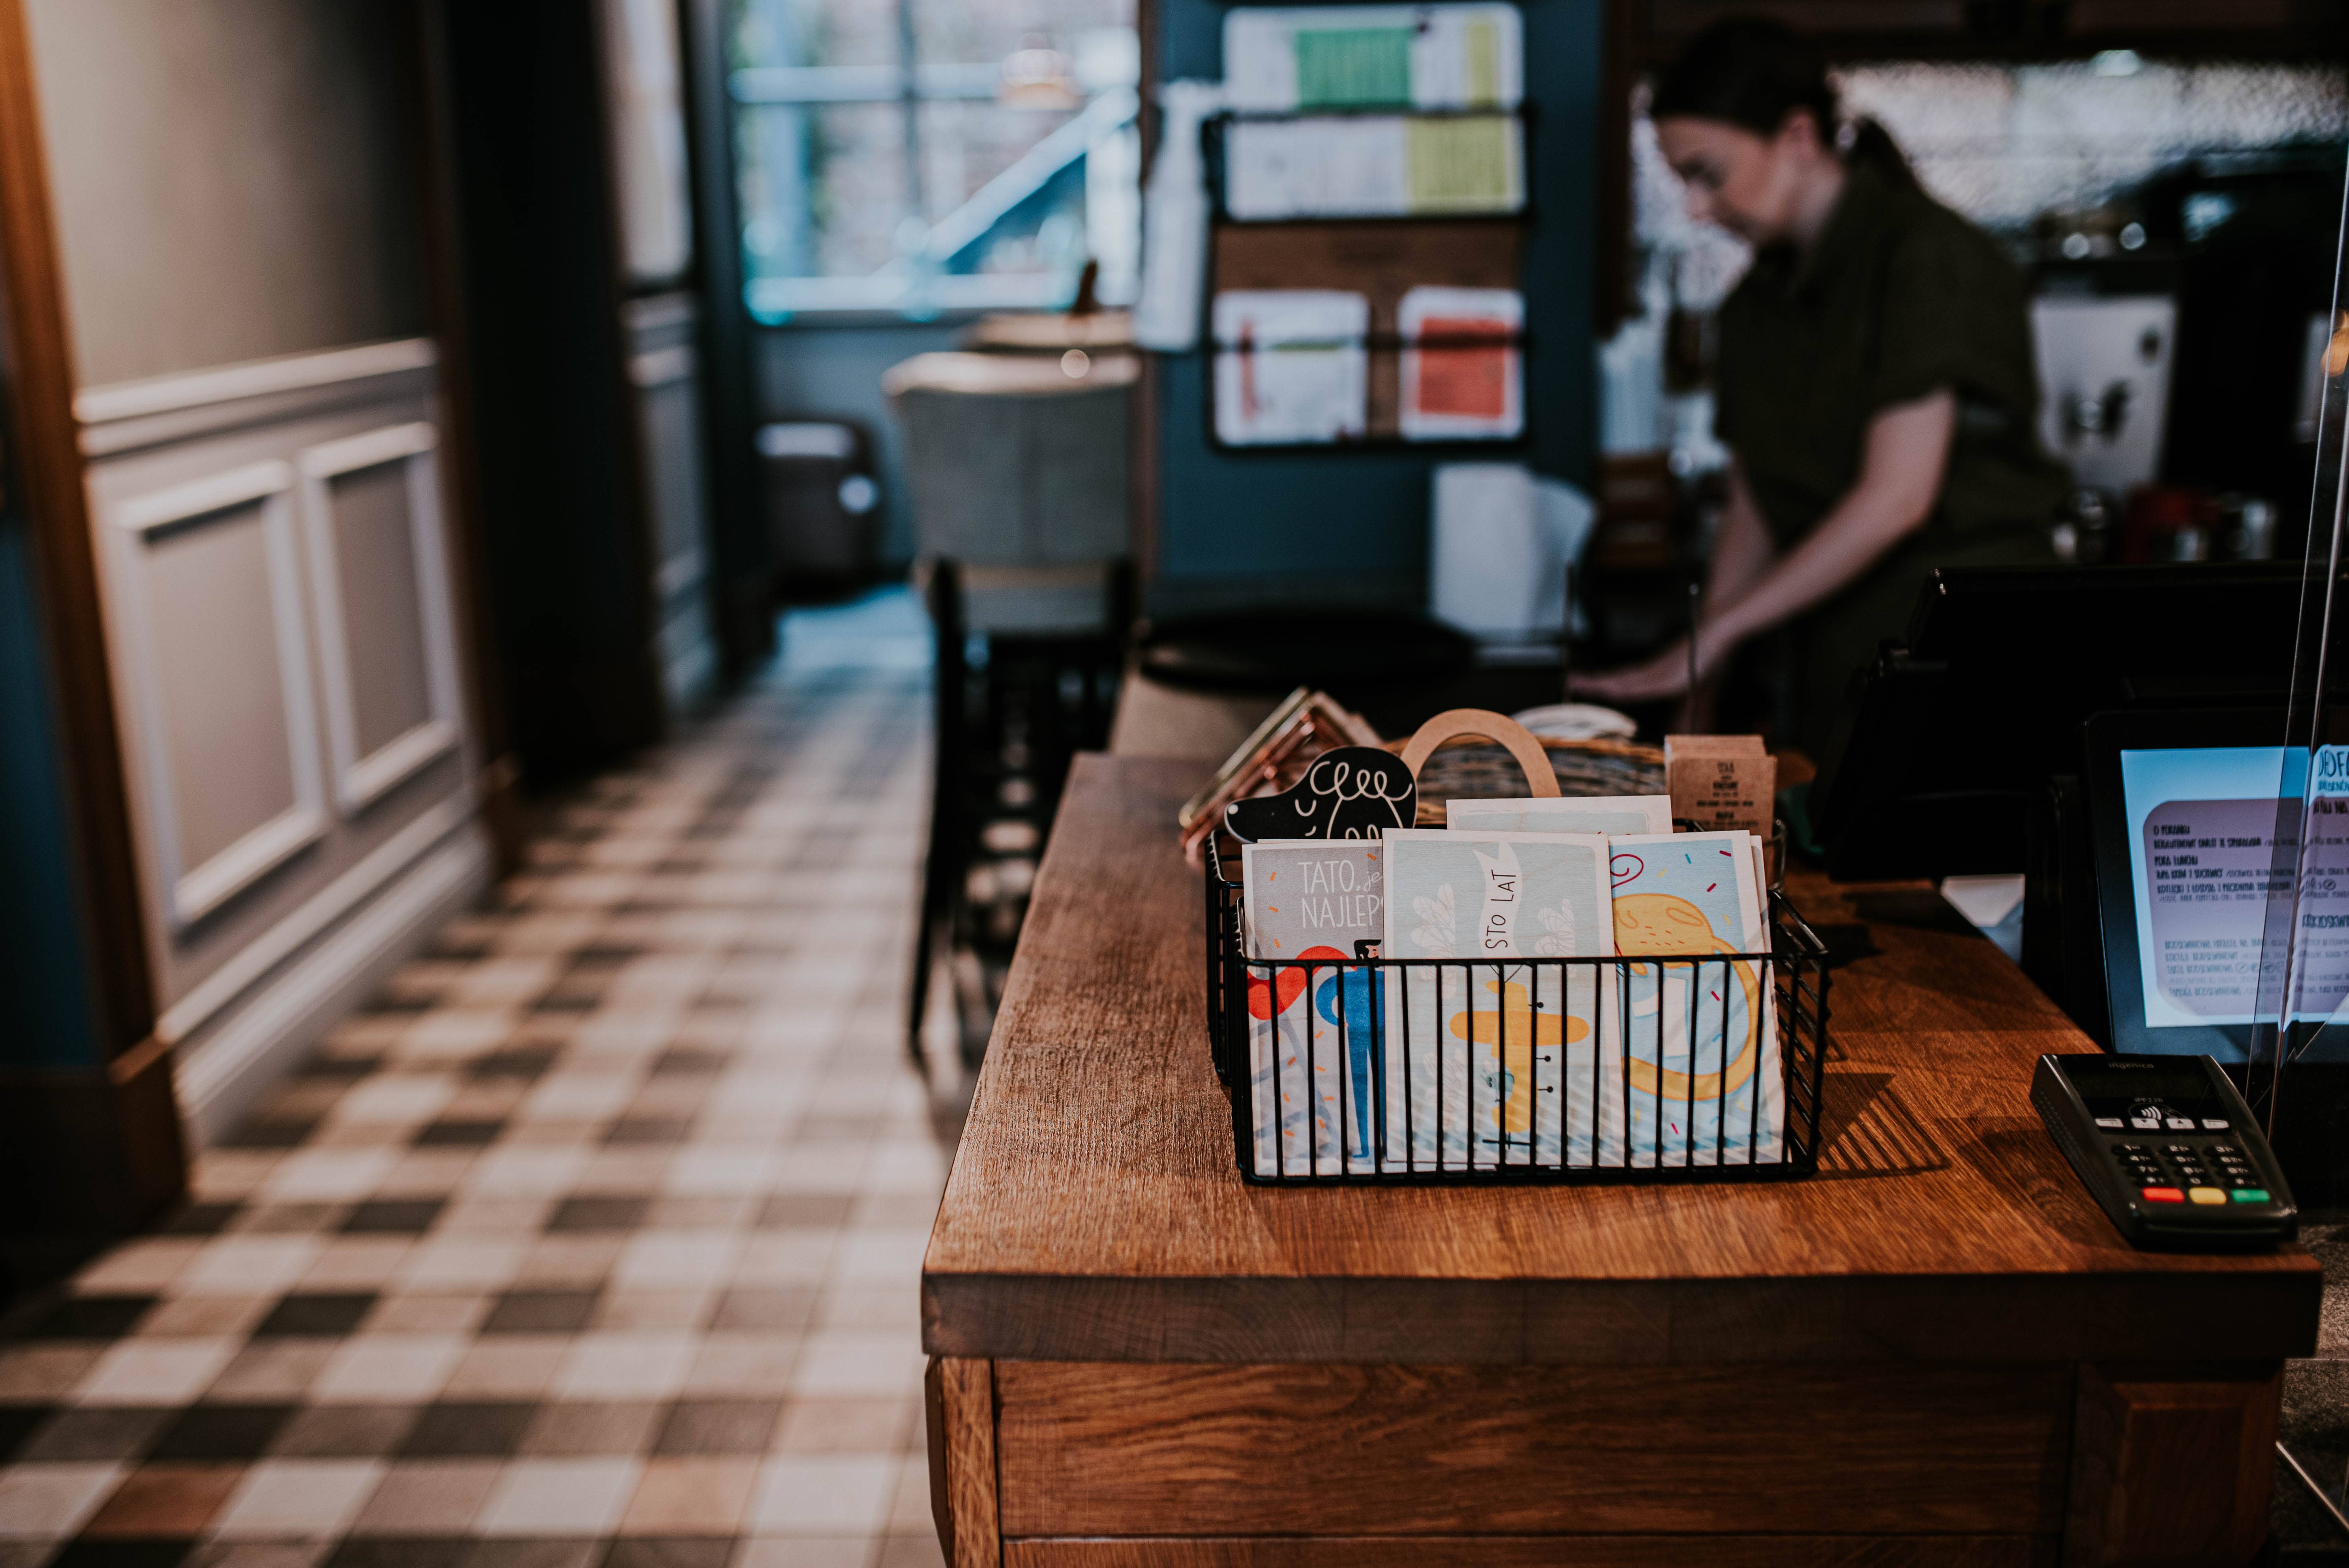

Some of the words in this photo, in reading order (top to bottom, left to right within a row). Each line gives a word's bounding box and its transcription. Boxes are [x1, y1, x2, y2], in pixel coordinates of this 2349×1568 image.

[1298, 860, 1360, 894] TATO,
[1491, 869, 1516, 901] LAT
[1302, 895, 1383, 928] NAJLEP
[1485, 915, 1508, 949] STO
